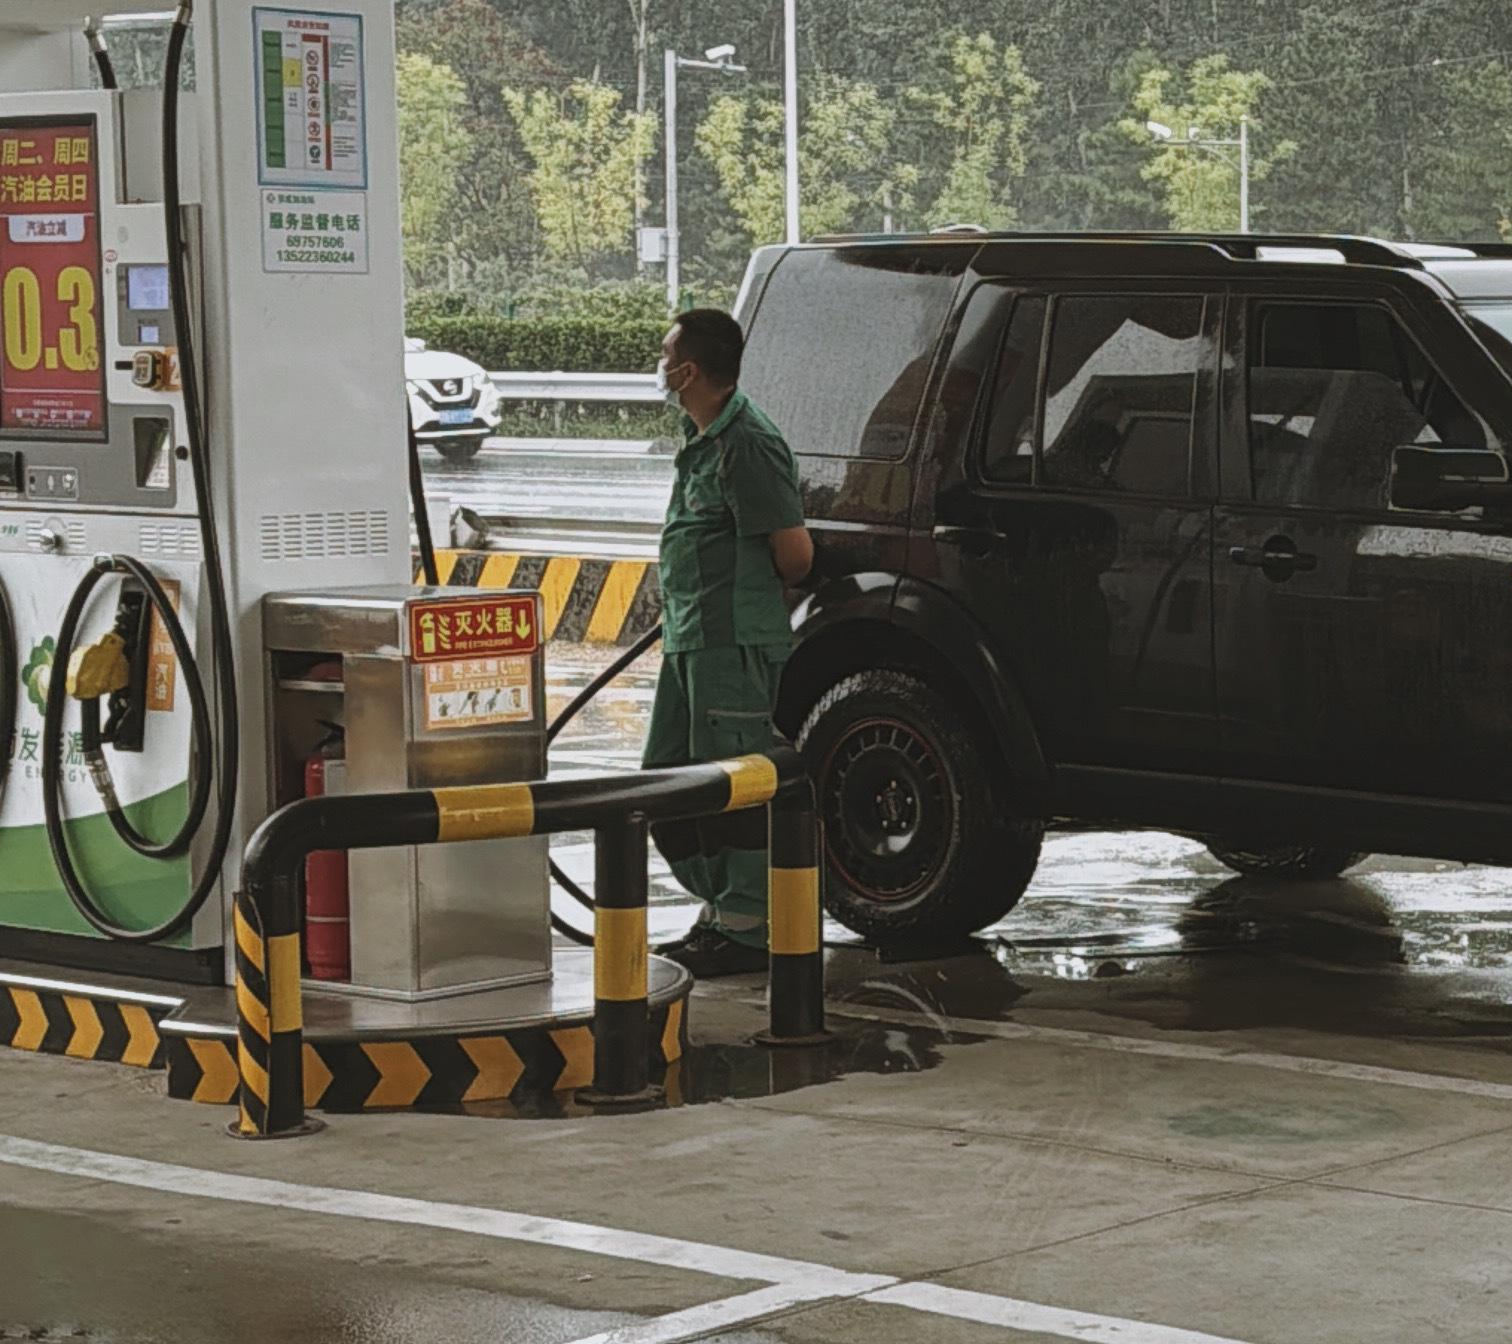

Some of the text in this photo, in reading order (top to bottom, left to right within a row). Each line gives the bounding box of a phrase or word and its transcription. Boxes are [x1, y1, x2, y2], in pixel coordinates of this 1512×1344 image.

[1, 174, 87, 202] 汽油会员日
[269, 212, 360, 232] 服务监督电话
[454, 607, 513, 636] 灭火器
